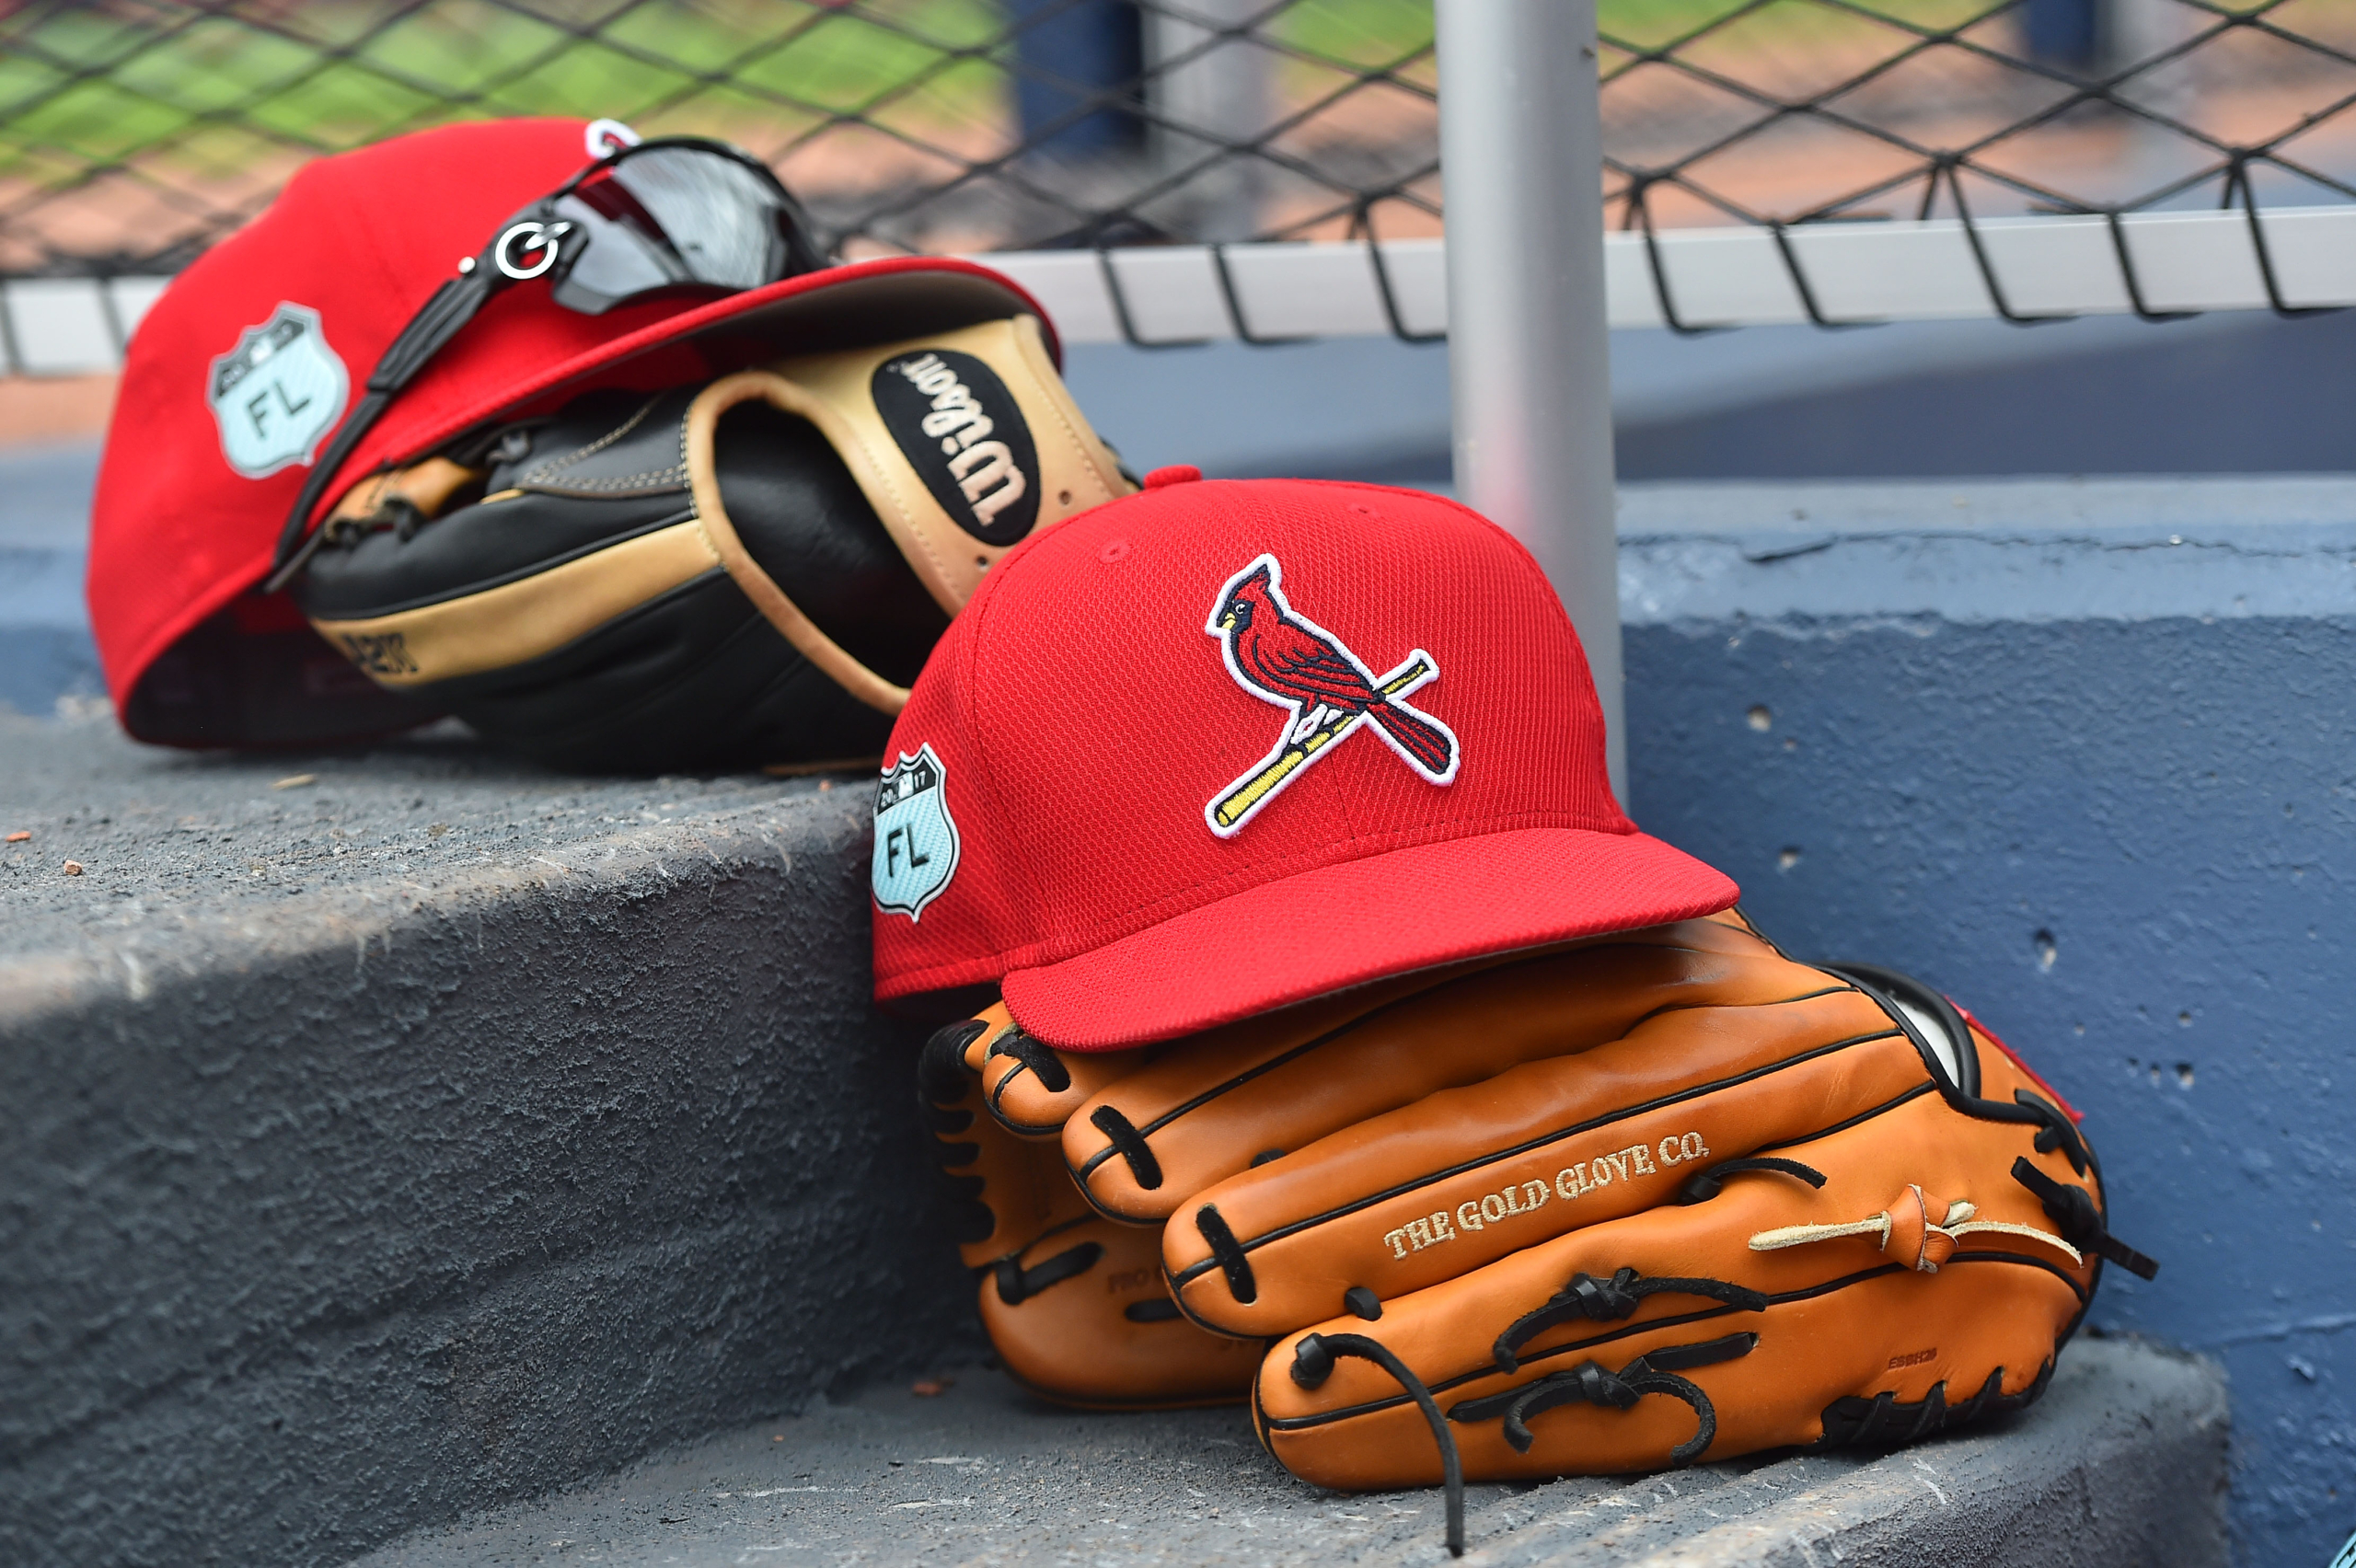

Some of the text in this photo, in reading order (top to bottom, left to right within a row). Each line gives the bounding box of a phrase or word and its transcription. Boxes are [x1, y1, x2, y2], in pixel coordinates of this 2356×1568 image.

[247, 379, 313, 438] FL
[899, 352, 1027, 527] Wilson
[914, 770, 927, 789] 17
[887, 823, 930, 878] FL
[1382, 1131, 1711, 1261] THE GOLD GLOVE CO.
